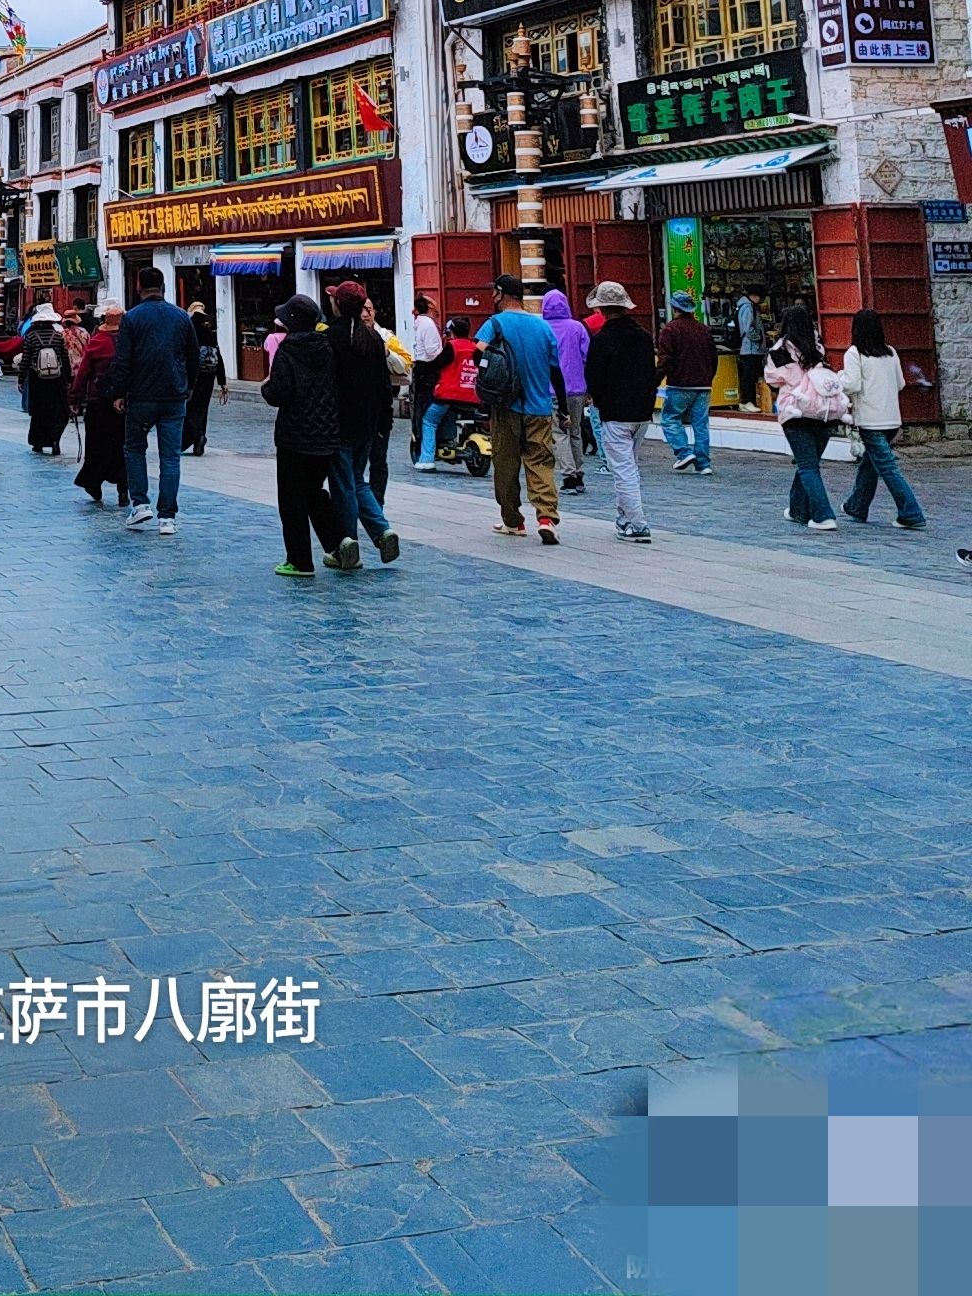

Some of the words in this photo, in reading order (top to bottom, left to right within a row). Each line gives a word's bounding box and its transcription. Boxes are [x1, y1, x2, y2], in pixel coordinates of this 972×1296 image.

[882, 19, 925, 32] 网红打卡点
[858, 42, 928, 58] 由此请上三楼
[934, 244, 972, 254] 探野观景
